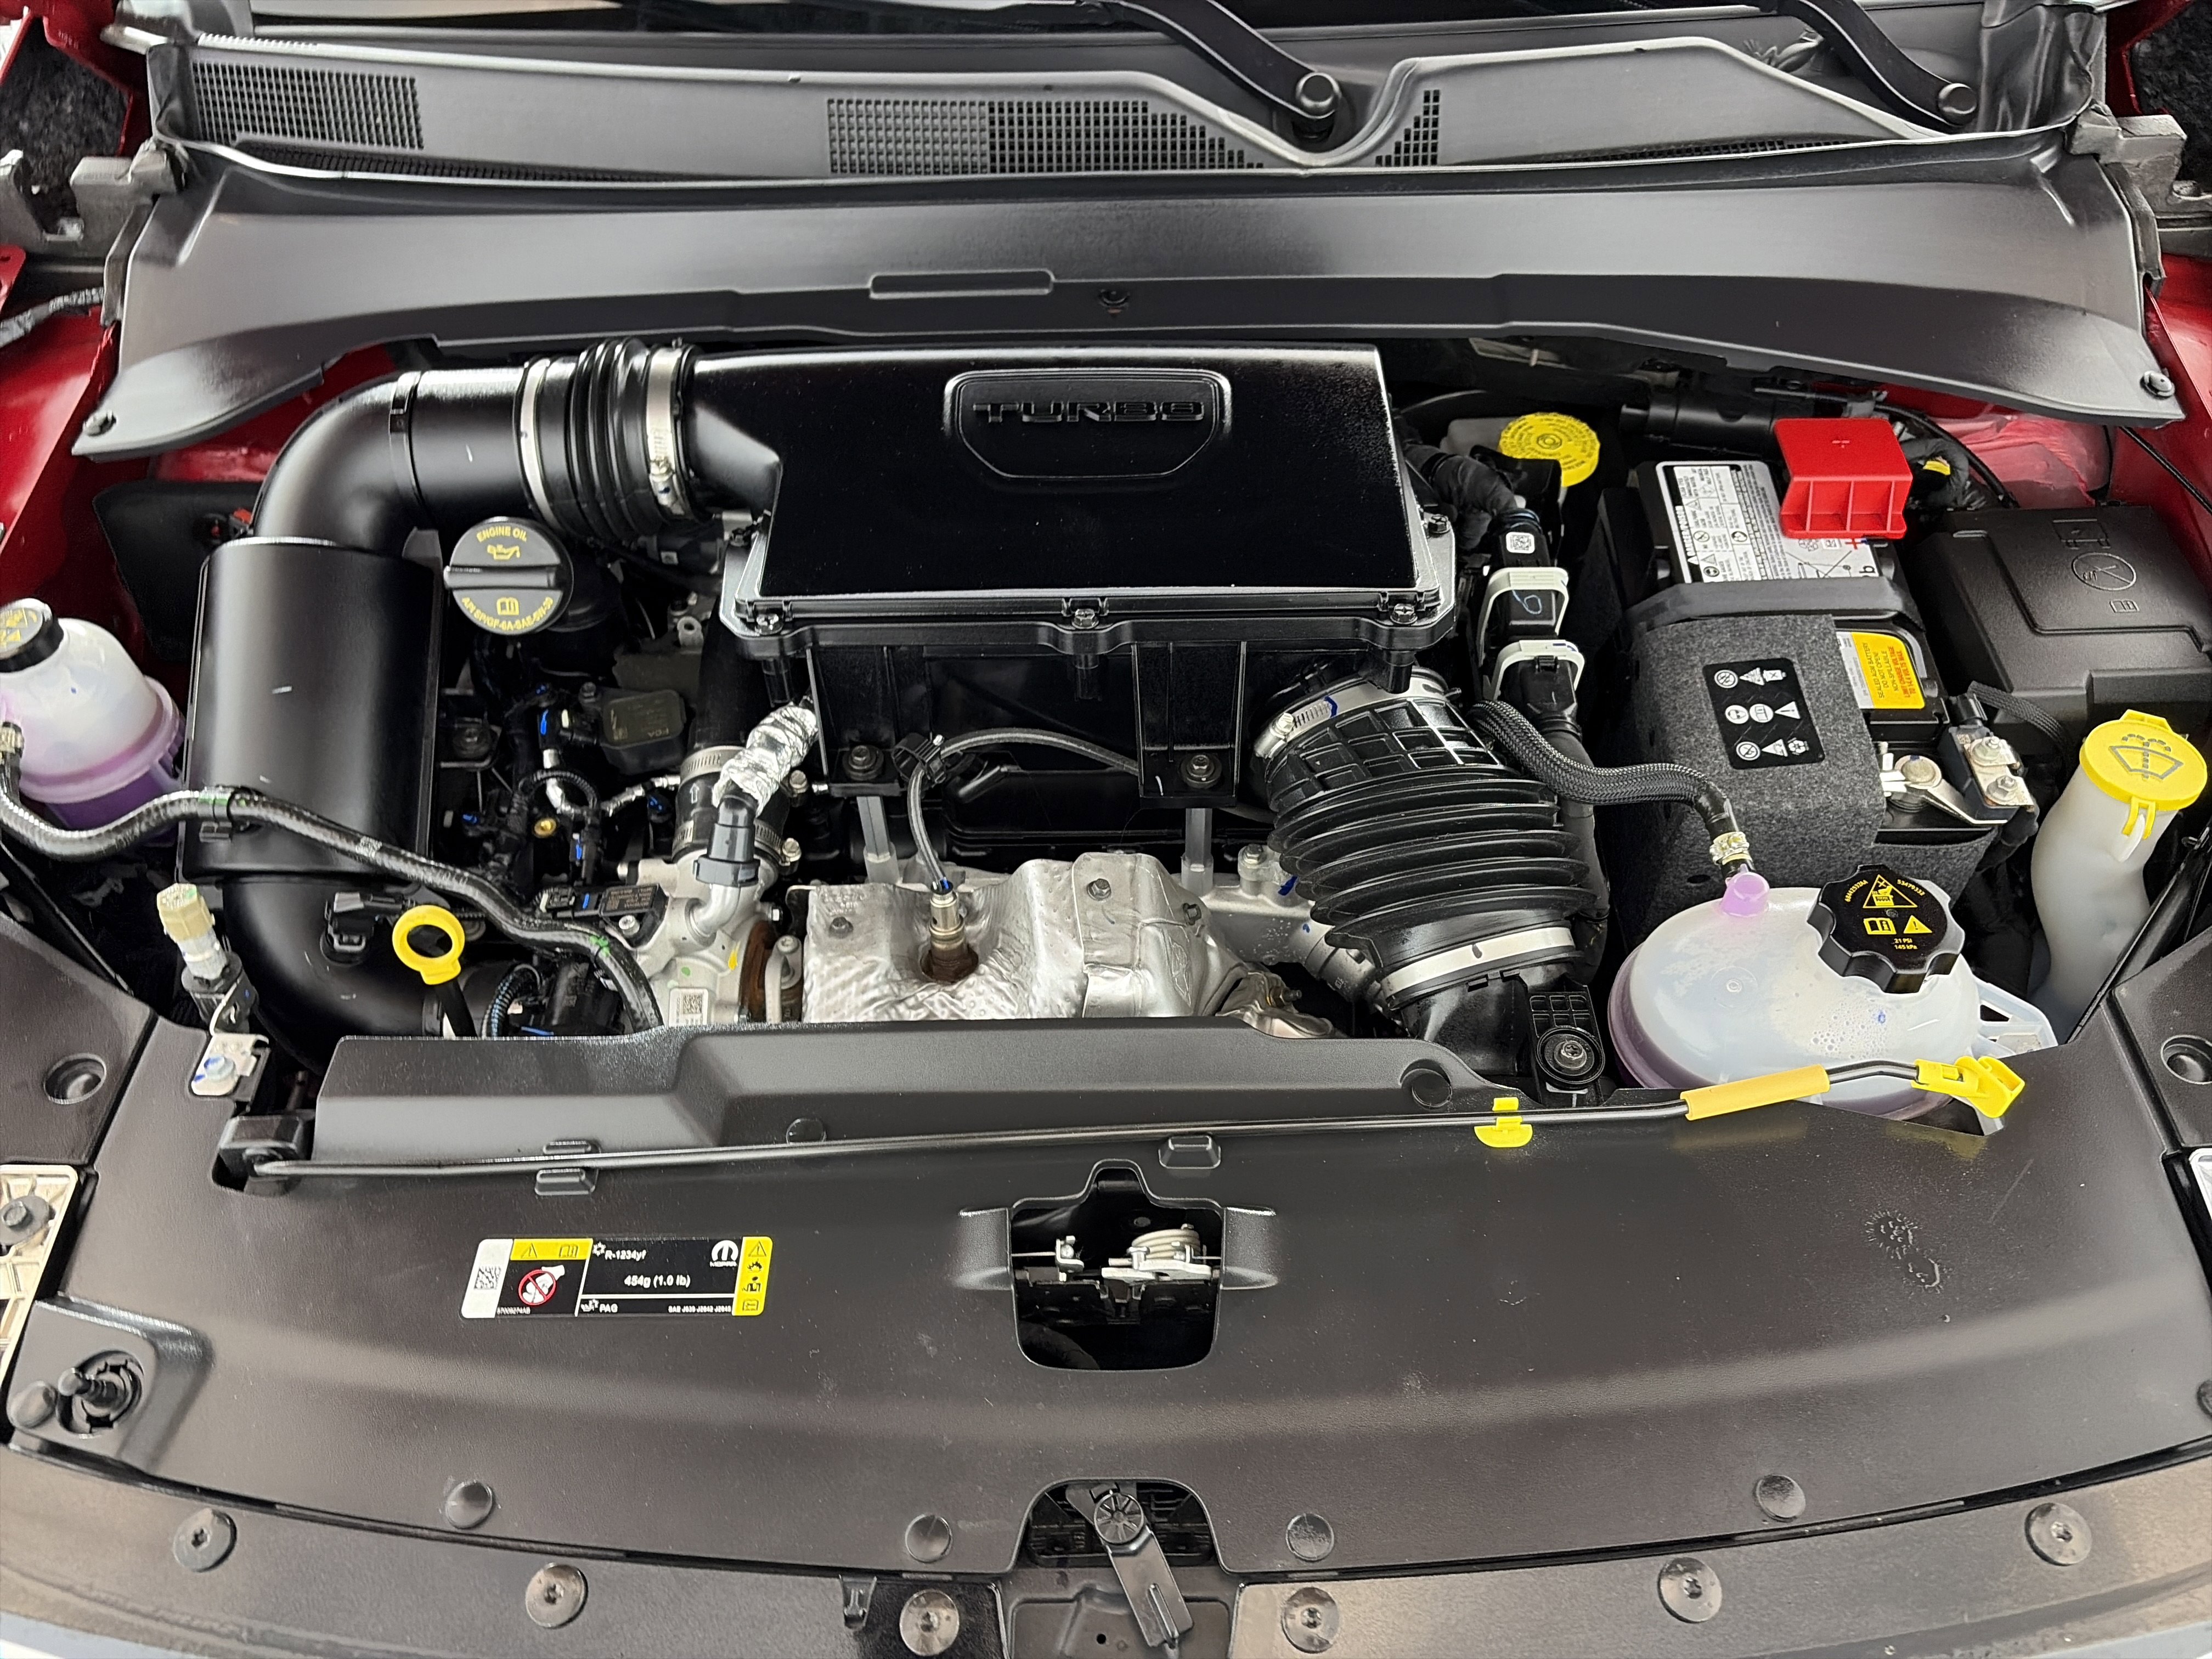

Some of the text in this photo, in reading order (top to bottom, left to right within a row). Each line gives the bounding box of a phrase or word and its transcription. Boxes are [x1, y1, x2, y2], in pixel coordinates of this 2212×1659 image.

[973, 401, 1204, 422] TURBO
[476, 526, 527, 543] ENGINE OIL
[605, 1250, 646, 1261] R-1234yf
[624, 1274, 691, 1288] 454g (1.0 lb)
[600, 1304, 618, 1312] PAG
